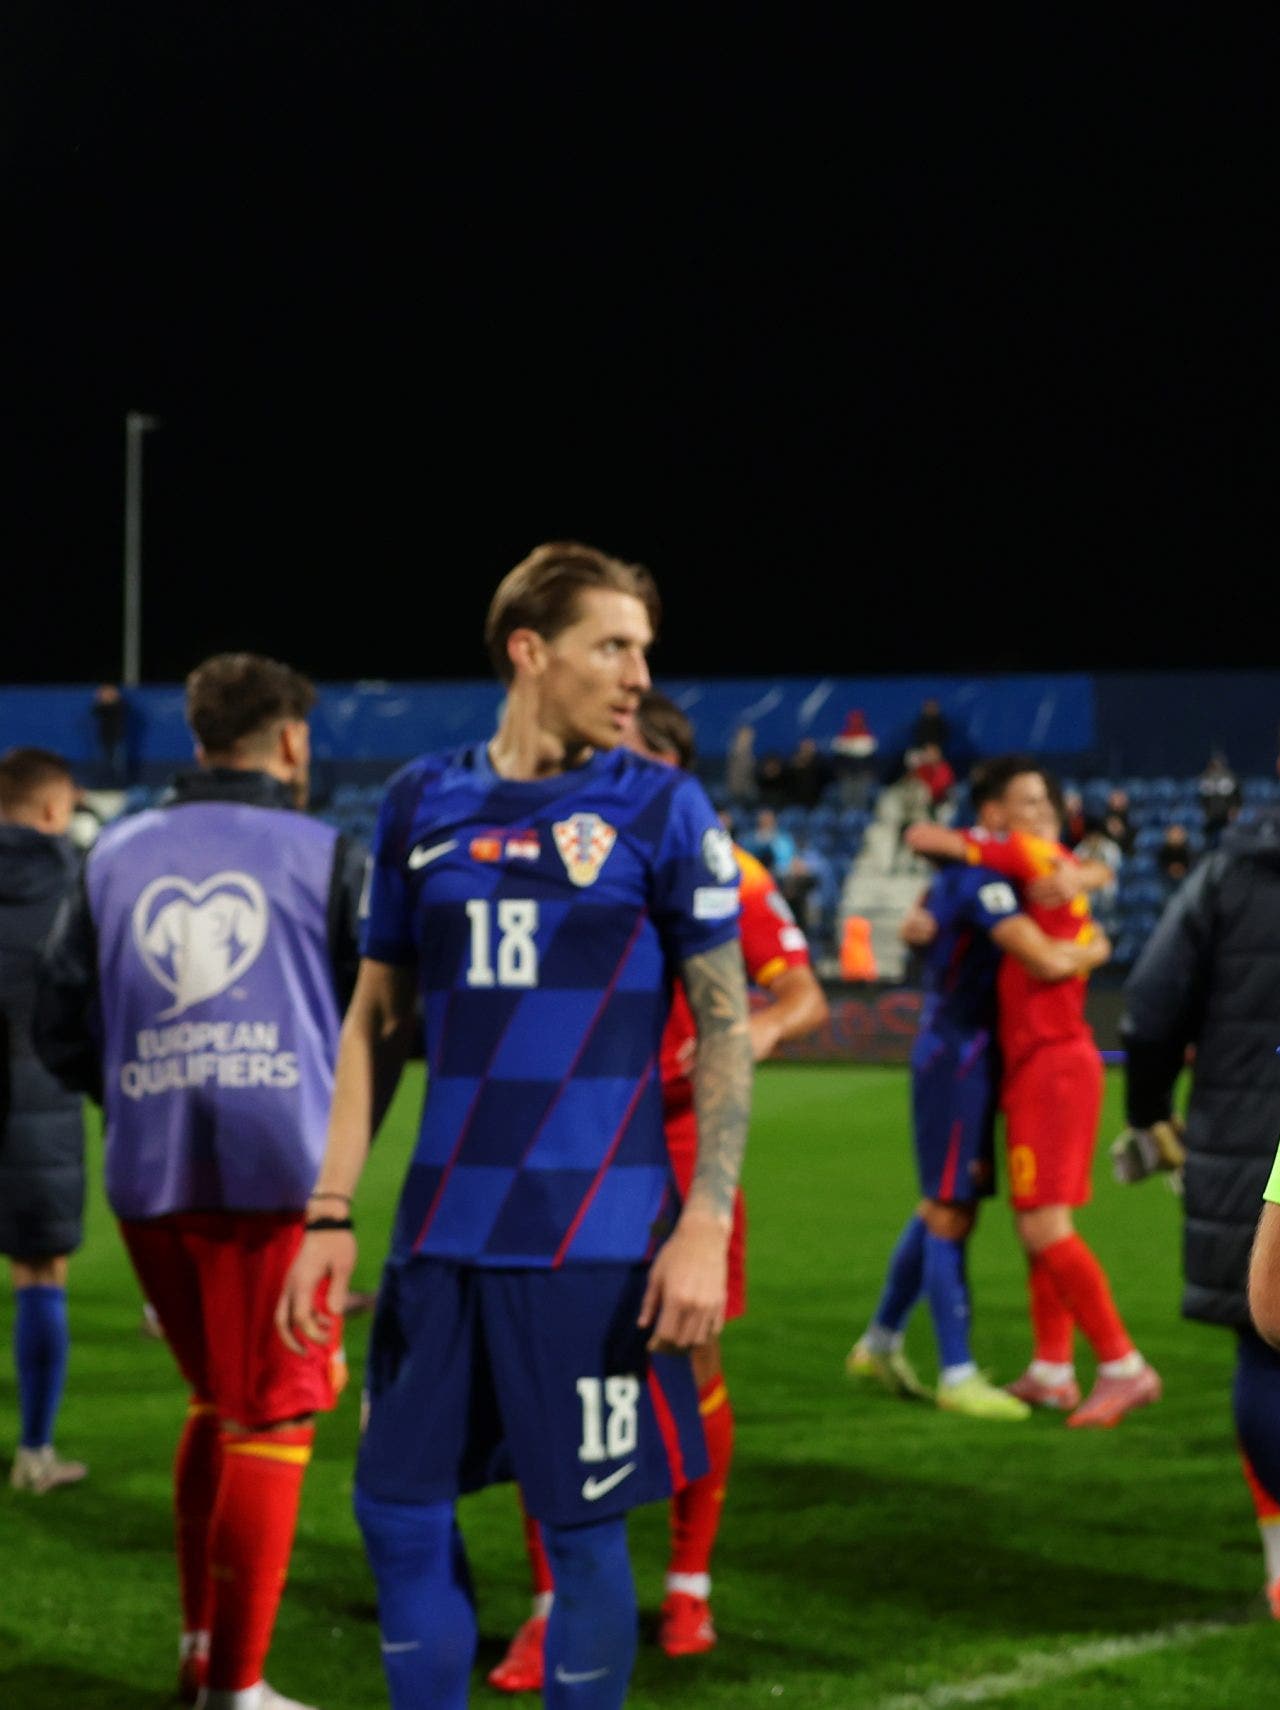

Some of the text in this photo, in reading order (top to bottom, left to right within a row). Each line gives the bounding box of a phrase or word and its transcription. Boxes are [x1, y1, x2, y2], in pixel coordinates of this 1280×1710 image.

[466, 899, 539, 987] 18
[137, 1022, 278, 1060] EUROPEAN
[120, 1052, 299, 1100] QUALIFIERS
[576, 1376, 639, 1463] 18
